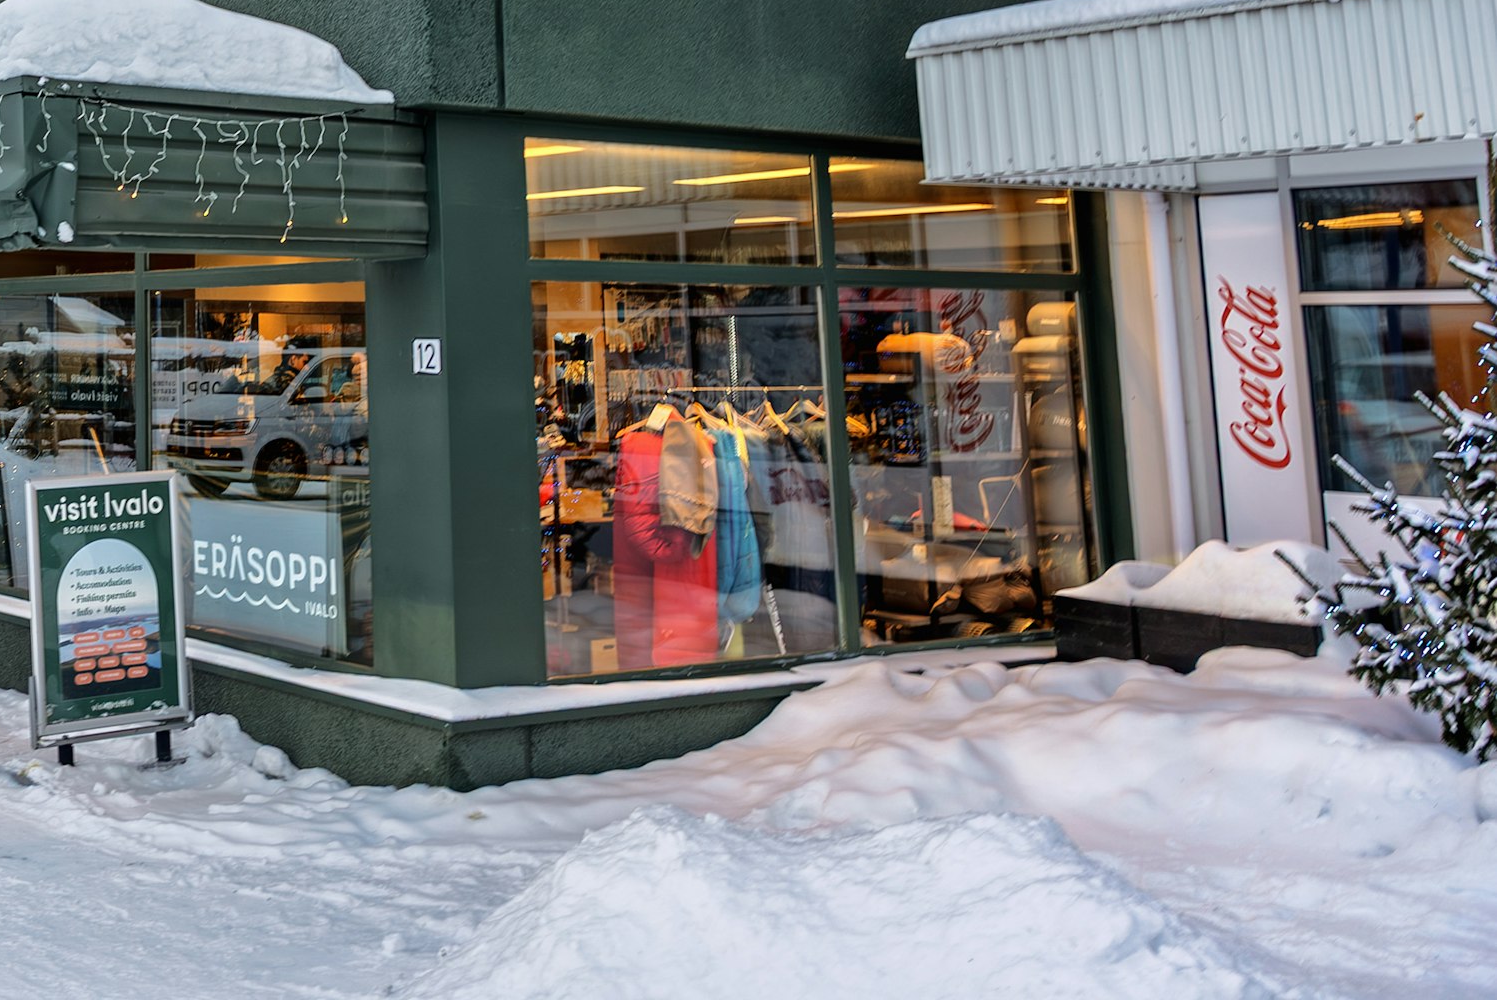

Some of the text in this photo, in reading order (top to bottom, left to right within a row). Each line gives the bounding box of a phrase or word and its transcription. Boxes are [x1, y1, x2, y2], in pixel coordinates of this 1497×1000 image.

[417, 343, 436, 369] 12
[44, 488, 163, 522] visit Ivalo
[63, 520, 146, 535] BOOKING CENTRE
[106, 563, 143, 574] Activities
[193, 534, 337, 596] ERÄSOPPI
[76, 589, 137, 603] Fishing permits
[305, 601, 338, 619] IVALO
